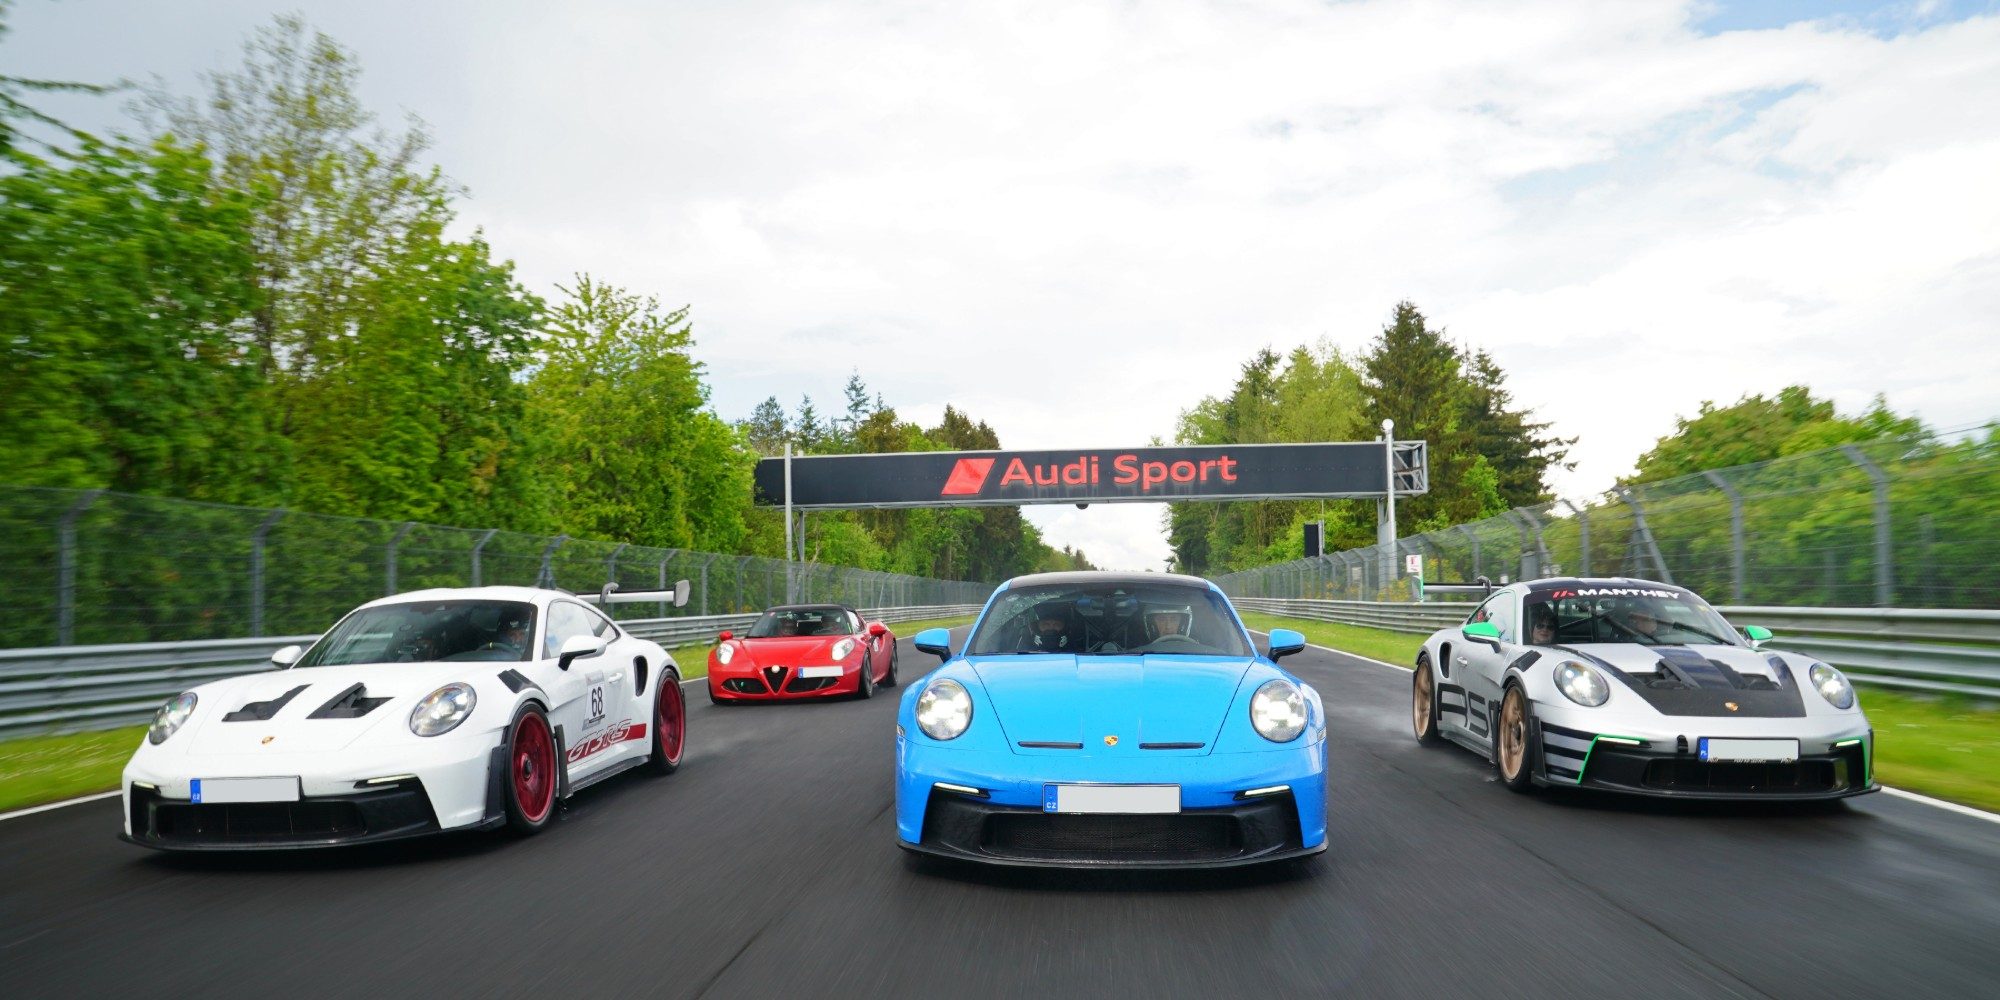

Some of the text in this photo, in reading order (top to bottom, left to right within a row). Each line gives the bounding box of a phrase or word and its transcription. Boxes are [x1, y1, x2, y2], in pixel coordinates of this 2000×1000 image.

[1000, 454, 1238, 492] Audi Sport
[1577, 588, 1680, 600] MANTHEY
[591, 686, 604, 718] 68
[192, 792, 200, 801] CZ
[1046, 801, 1057, 809] CZ
